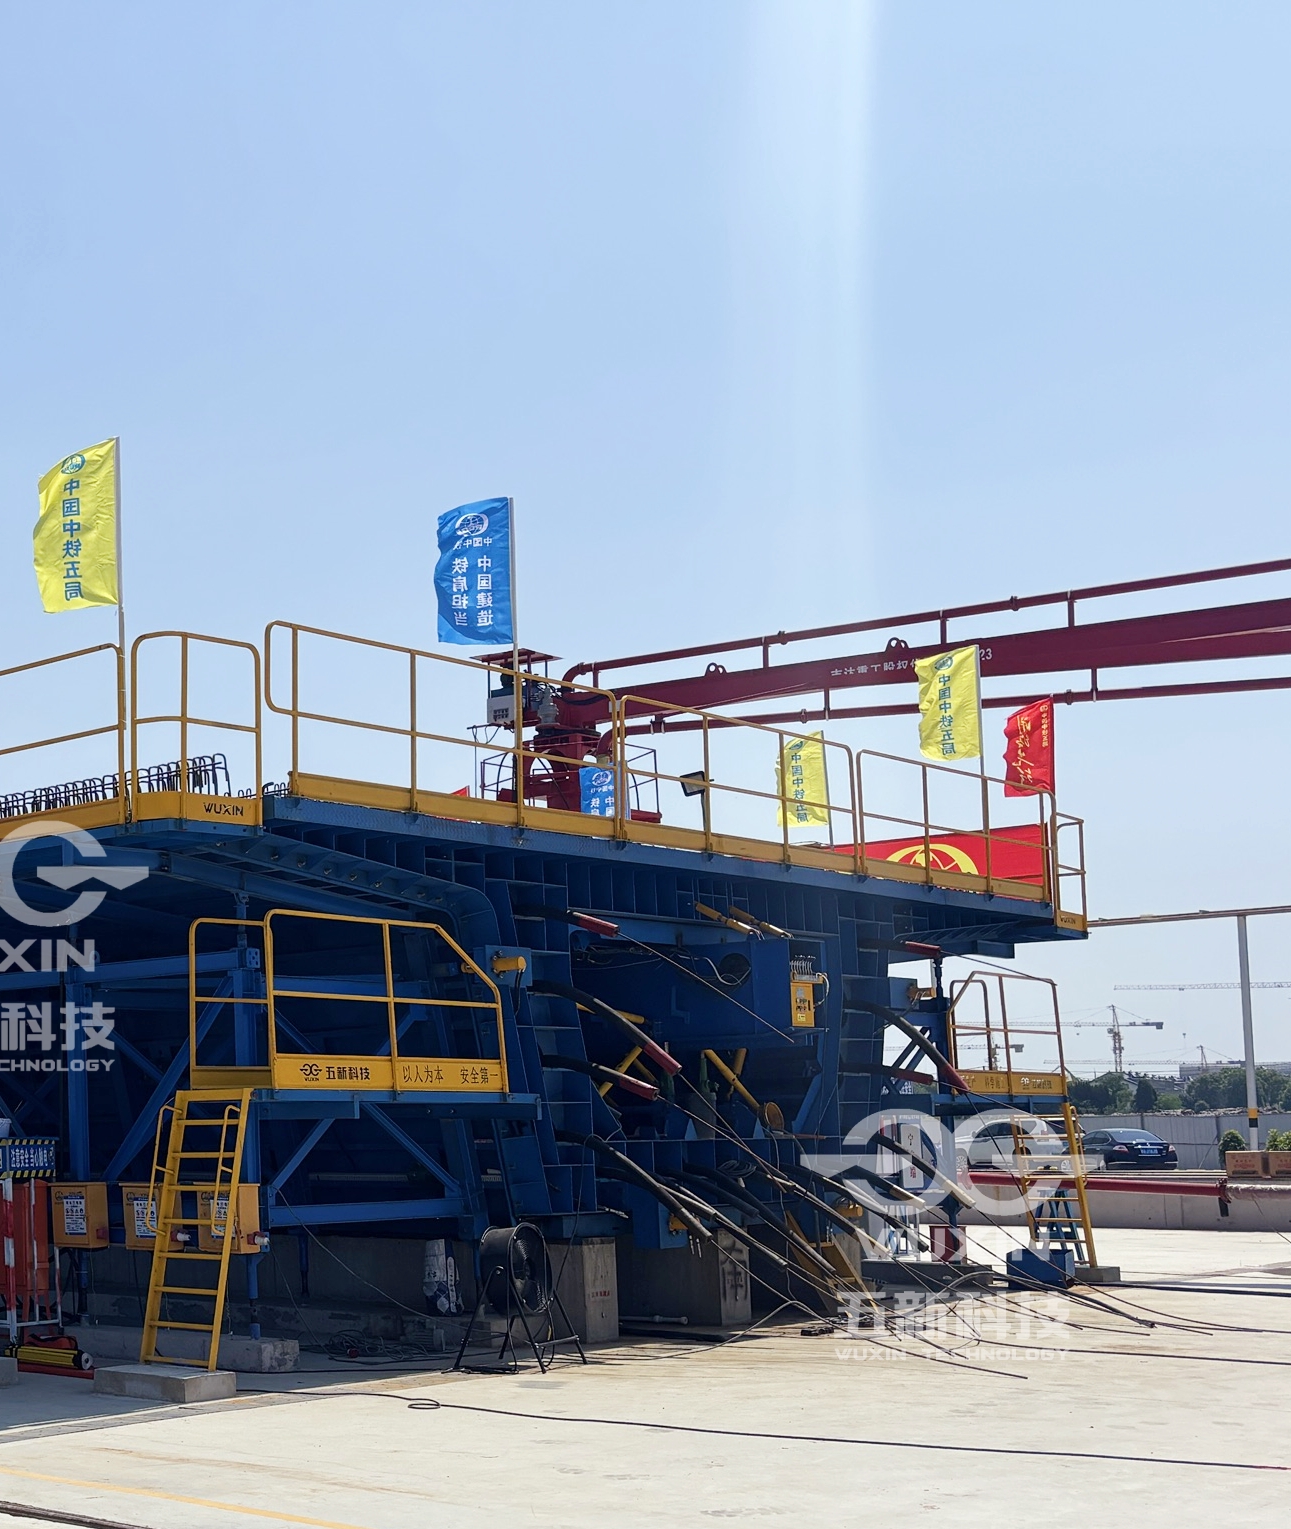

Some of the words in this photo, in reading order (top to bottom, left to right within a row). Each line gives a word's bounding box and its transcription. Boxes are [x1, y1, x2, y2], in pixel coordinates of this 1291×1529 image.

[203, 802, 244, 816] WUXIN
[325, 1066, 371, 1081] 五新科技
[402, 1064, 444, 1084] 以人为本
[460, 1066, 499, 1084] 安全第一
